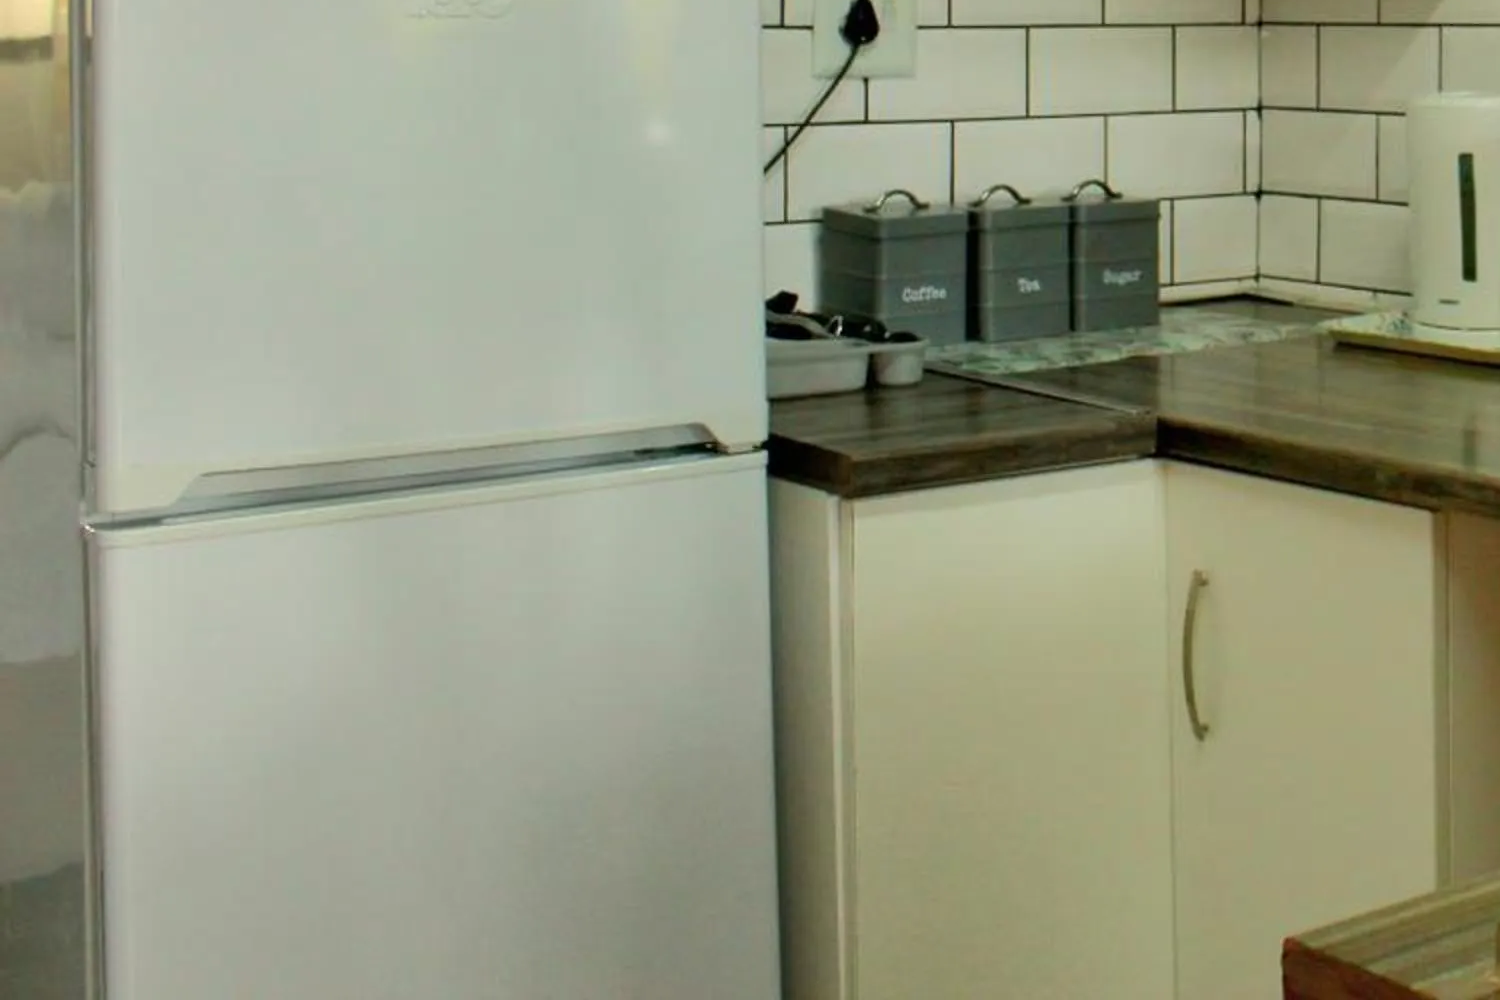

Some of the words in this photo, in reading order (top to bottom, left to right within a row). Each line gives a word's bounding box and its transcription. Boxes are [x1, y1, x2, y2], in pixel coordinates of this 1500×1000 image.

[1017, 276, 1041, 293] Tea
[1102, 268, 1143, 286] Sugar
[902, 286, 947, 303] Coffee
